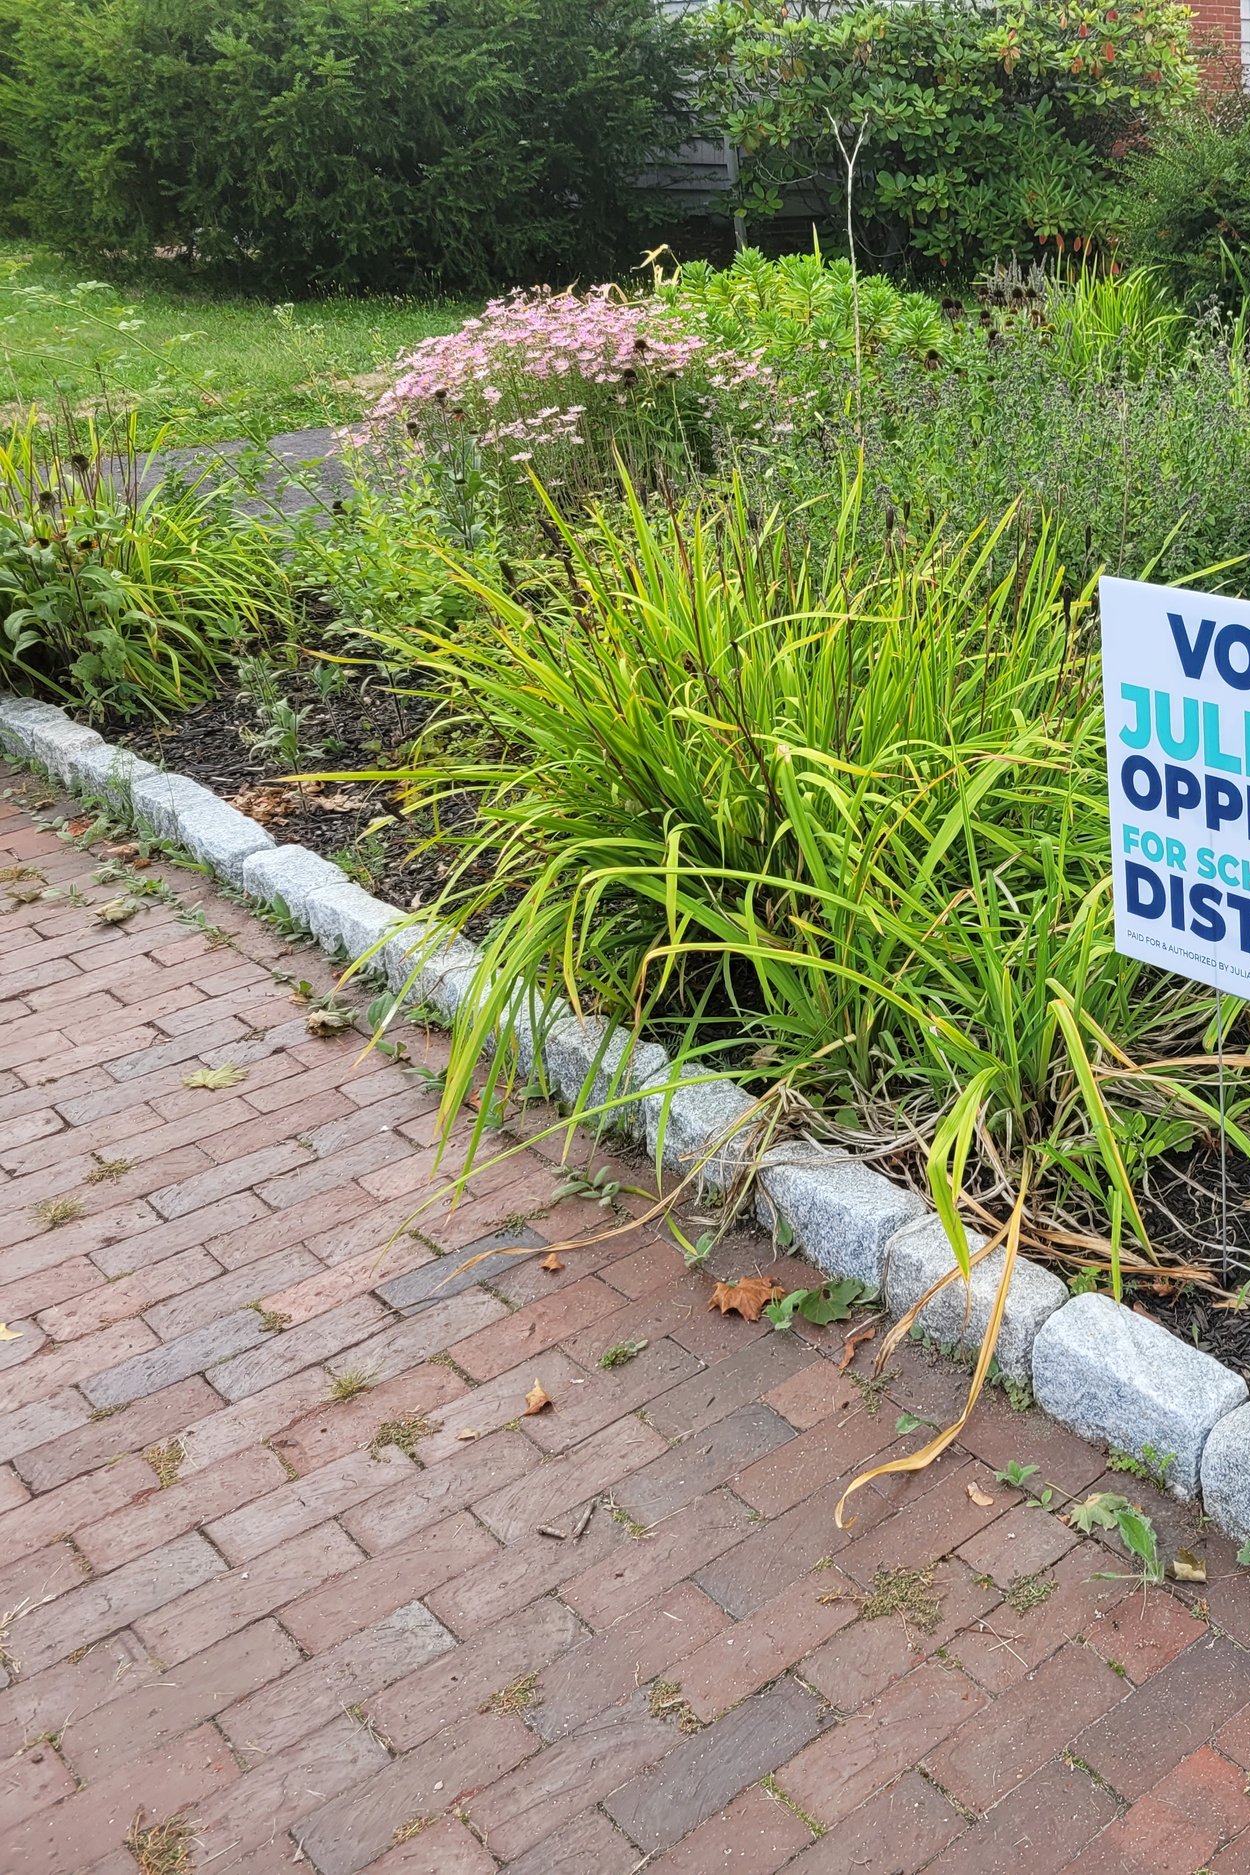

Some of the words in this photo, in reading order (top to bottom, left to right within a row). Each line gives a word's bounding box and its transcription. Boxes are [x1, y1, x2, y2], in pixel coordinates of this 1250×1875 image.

[1123, 824, 1186, 873] FOR
[1127, 929, 1145, 942] PAID
[1146, 936, 1161, 948] FOR
[1162, 942, 1168, 950] &
[1168, 944, 1217, 968] AUTHORIZED
[1219, 961, 1230, 972] BY
